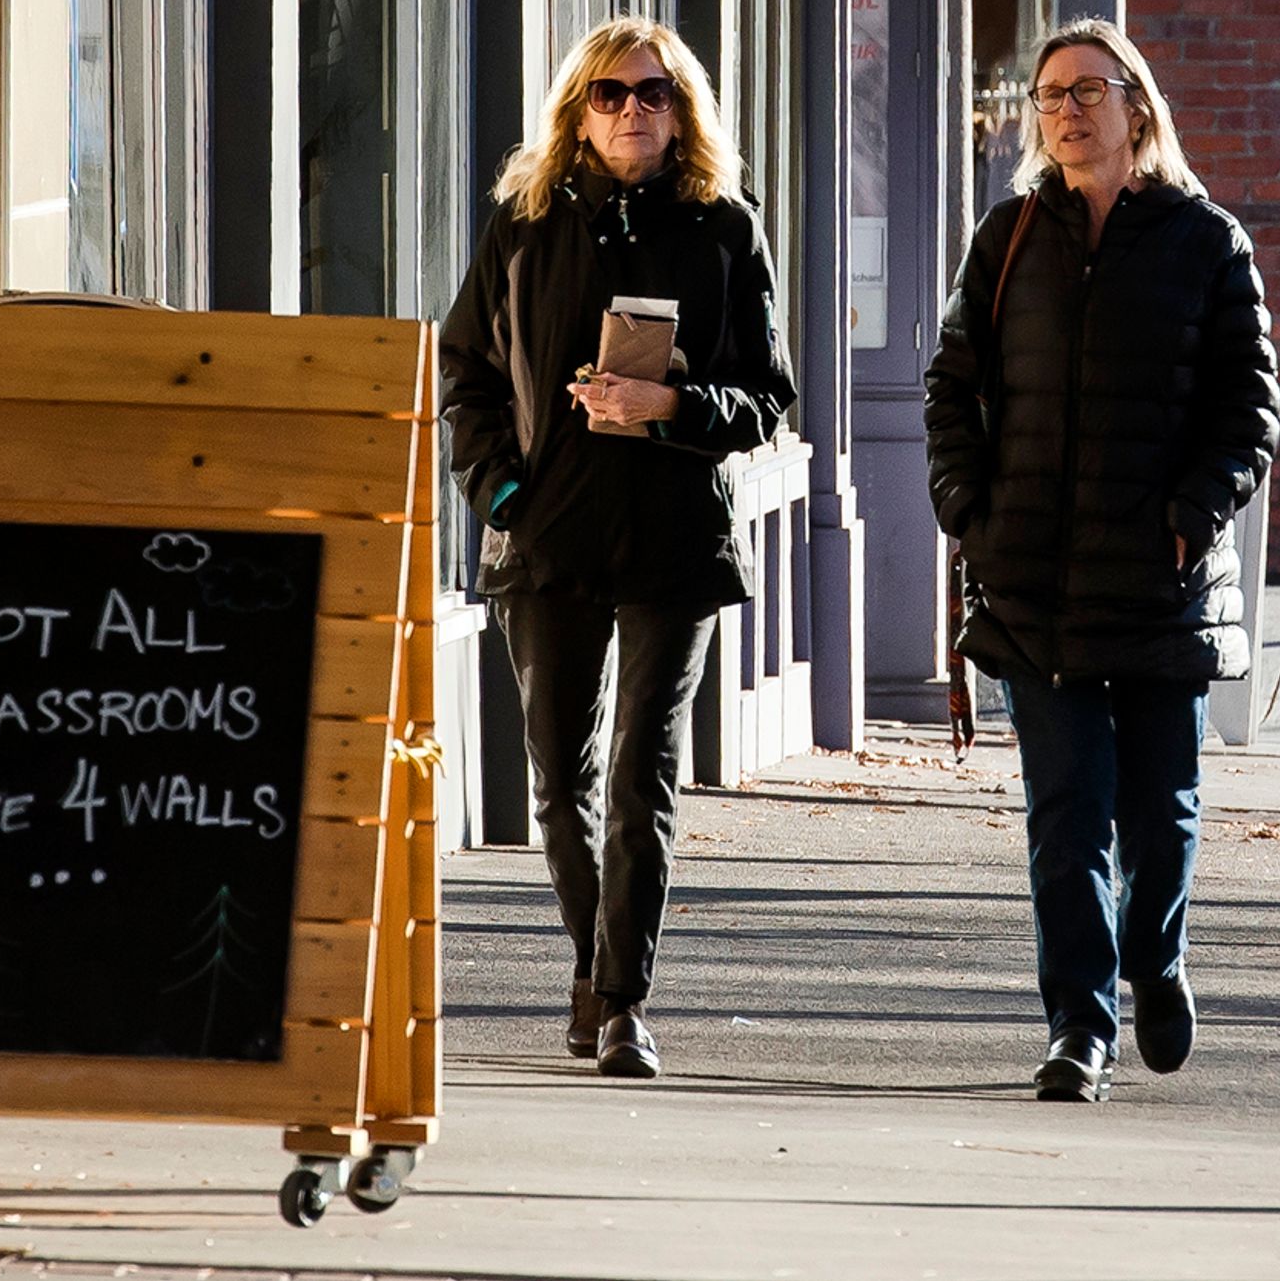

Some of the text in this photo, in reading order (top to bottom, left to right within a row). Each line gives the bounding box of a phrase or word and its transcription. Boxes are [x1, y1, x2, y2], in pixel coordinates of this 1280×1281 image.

[92, 587, 226, 655] ALL
[61, 758, 106, 842] 4
[120, 774, 286, 840] WALLS
